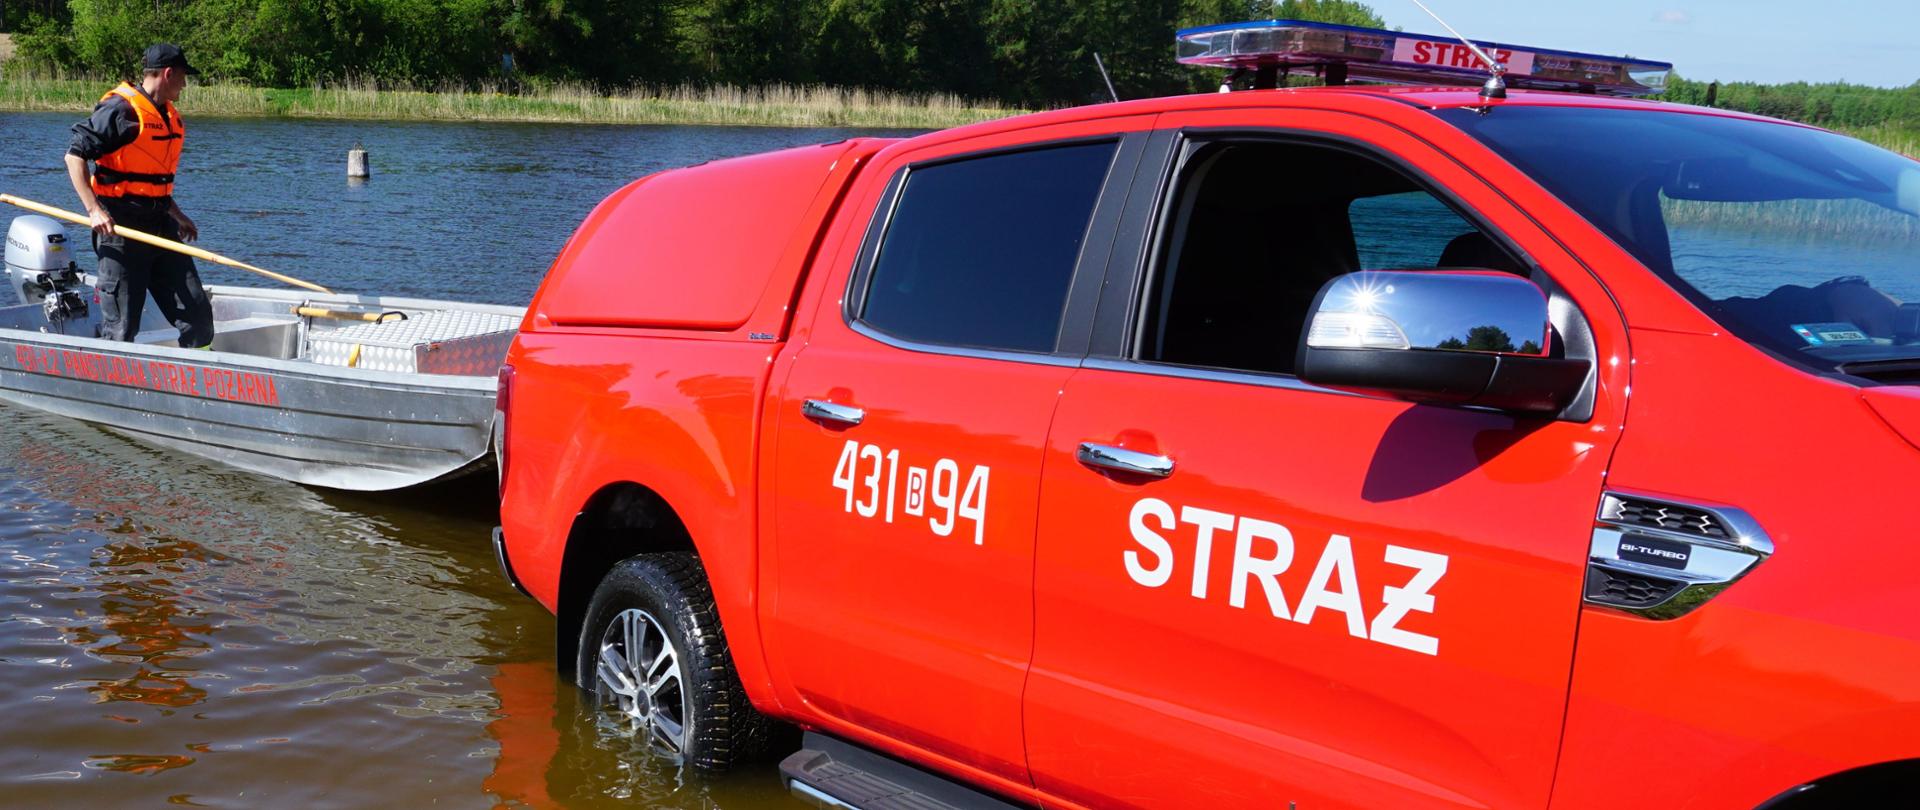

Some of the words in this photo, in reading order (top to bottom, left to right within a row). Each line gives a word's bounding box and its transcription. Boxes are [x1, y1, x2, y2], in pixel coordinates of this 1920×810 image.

[203, 367, 280, 405] POŻARNA
[1620, 543, 1687, 560] BI-TURBO
[1123, 497, 1450, 656] STRAŻ
